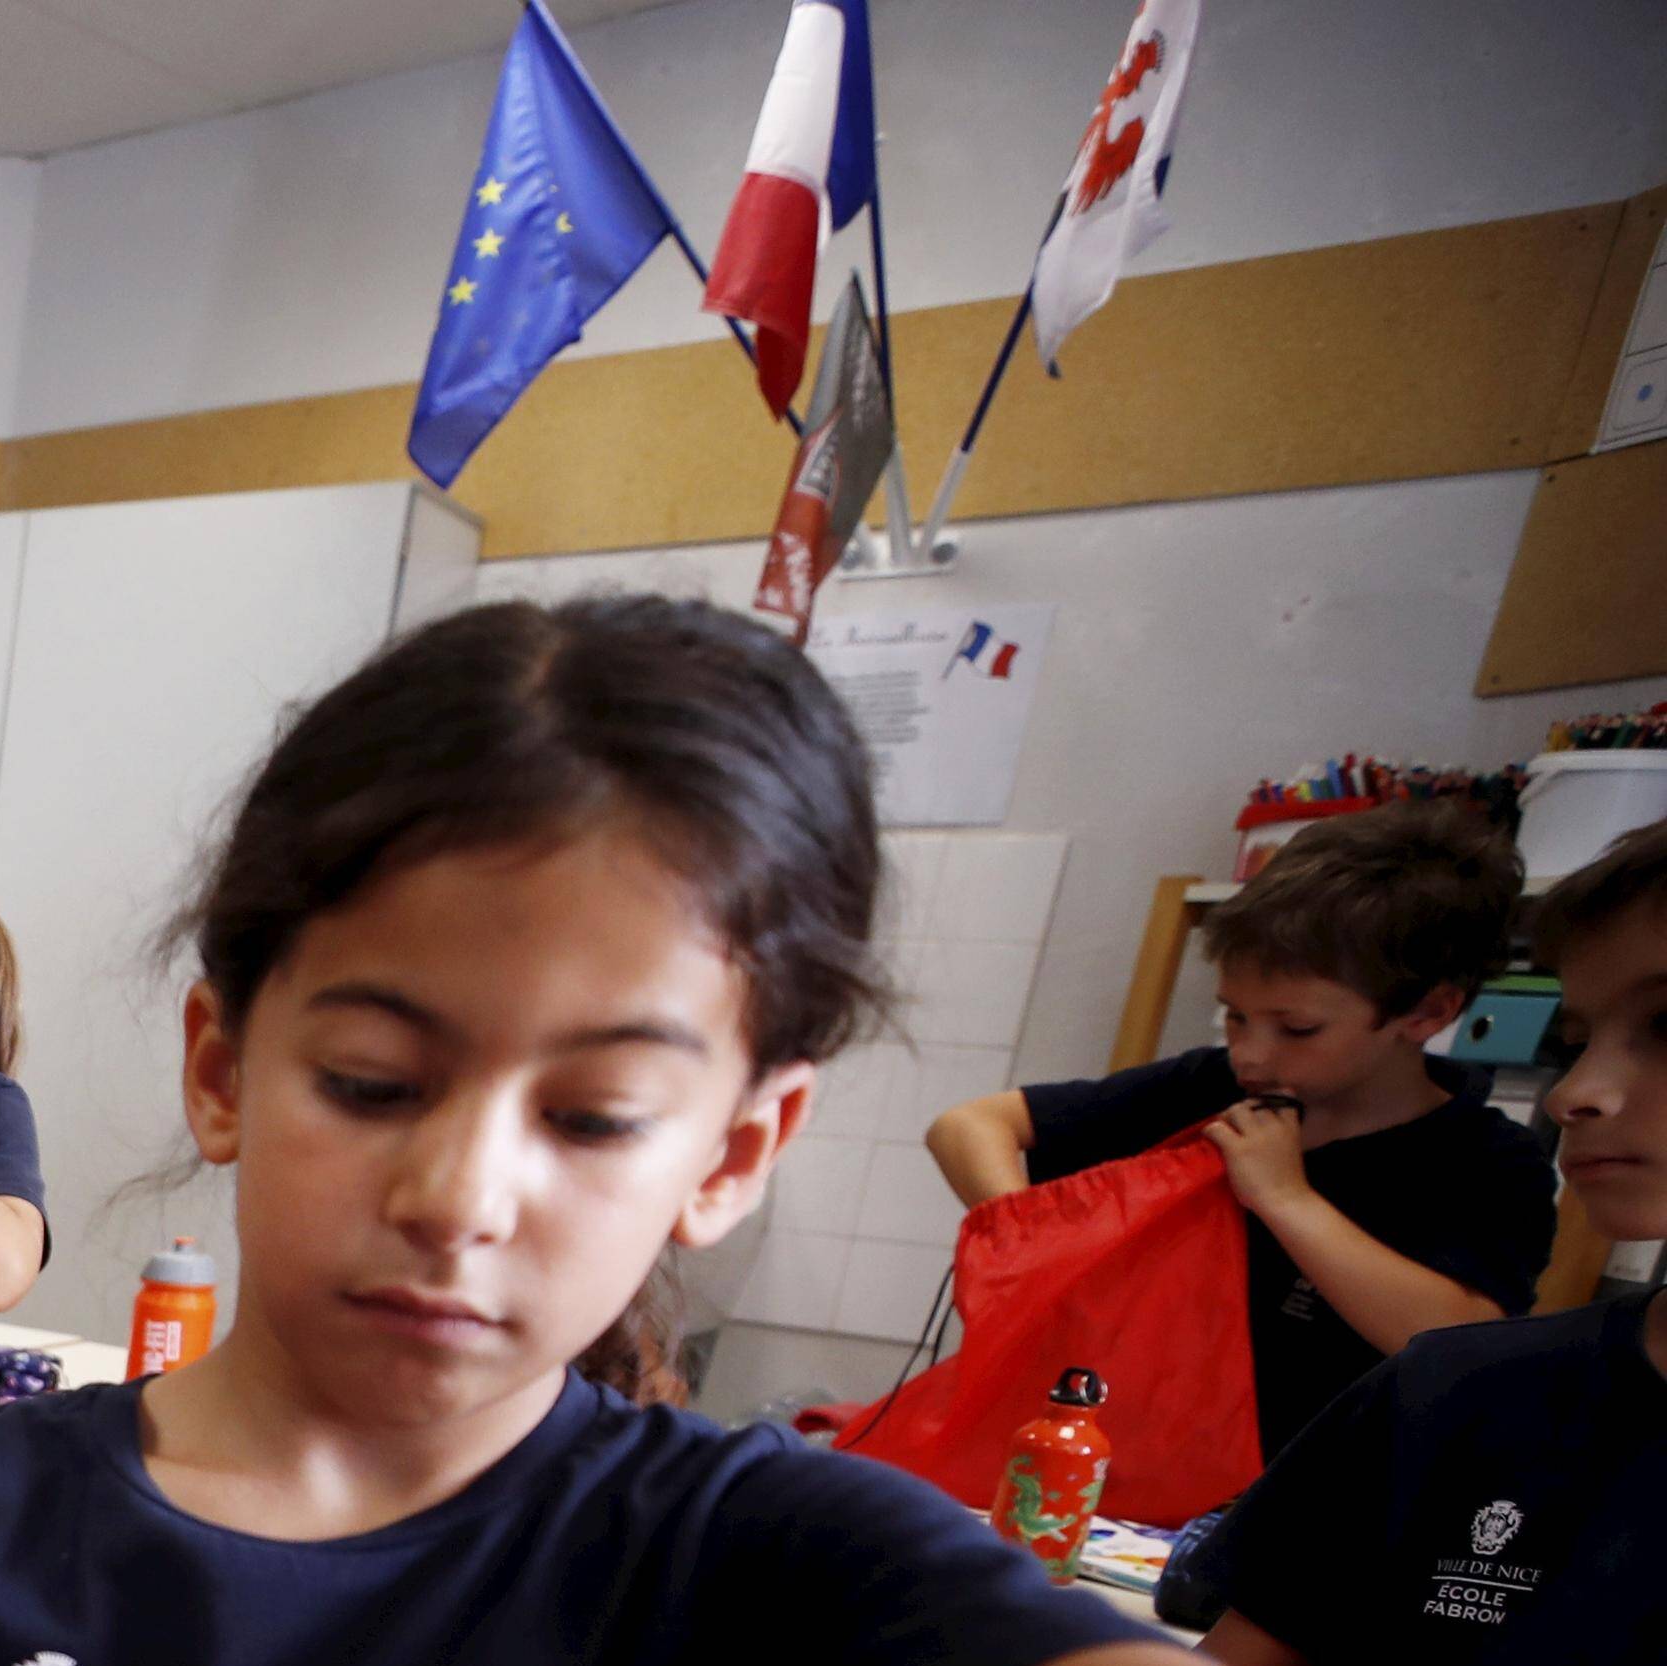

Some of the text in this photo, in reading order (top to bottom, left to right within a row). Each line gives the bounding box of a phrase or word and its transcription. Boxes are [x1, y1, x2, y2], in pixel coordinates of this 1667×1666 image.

[1470, 1560, 1494, 1576] DE
[1497, 1564, 1543, 1583] NICE
[1438, 1582, 1507, 1607] ÉCOLE
[1424, 1600, 1506, 1624] FABRON
